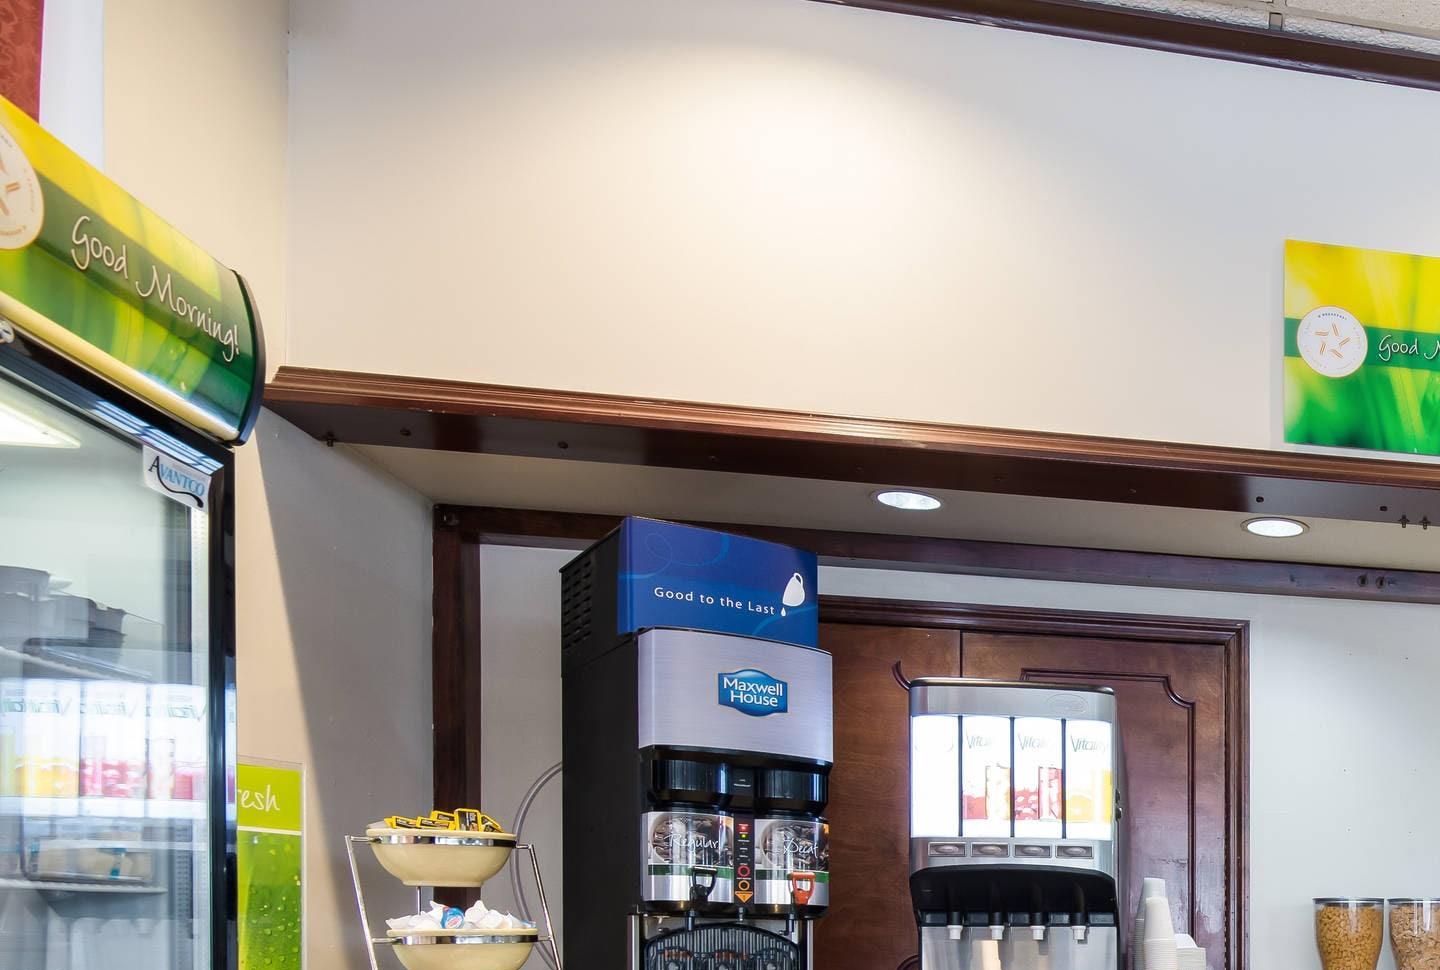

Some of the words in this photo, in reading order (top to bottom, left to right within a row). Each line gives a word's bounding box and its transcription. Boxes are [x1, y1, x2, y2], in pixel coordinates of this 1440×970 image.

[70, 215, 129, 279] Good
[135, 265, 240, 362] Morning!
[1378, 334, 1419, 362] Good
[148, 455, 205, 506] AVANTCO
[653, 586, 694, 602] Good
[699, 593, 715, 605] to
[719, 597, 743, 609] the
[747, 601, 776, 616] Last
[723, 676, 783, 697] Maxwell
[730, 689, 779, 707] House
[663, 833, 719, 853] Regular
